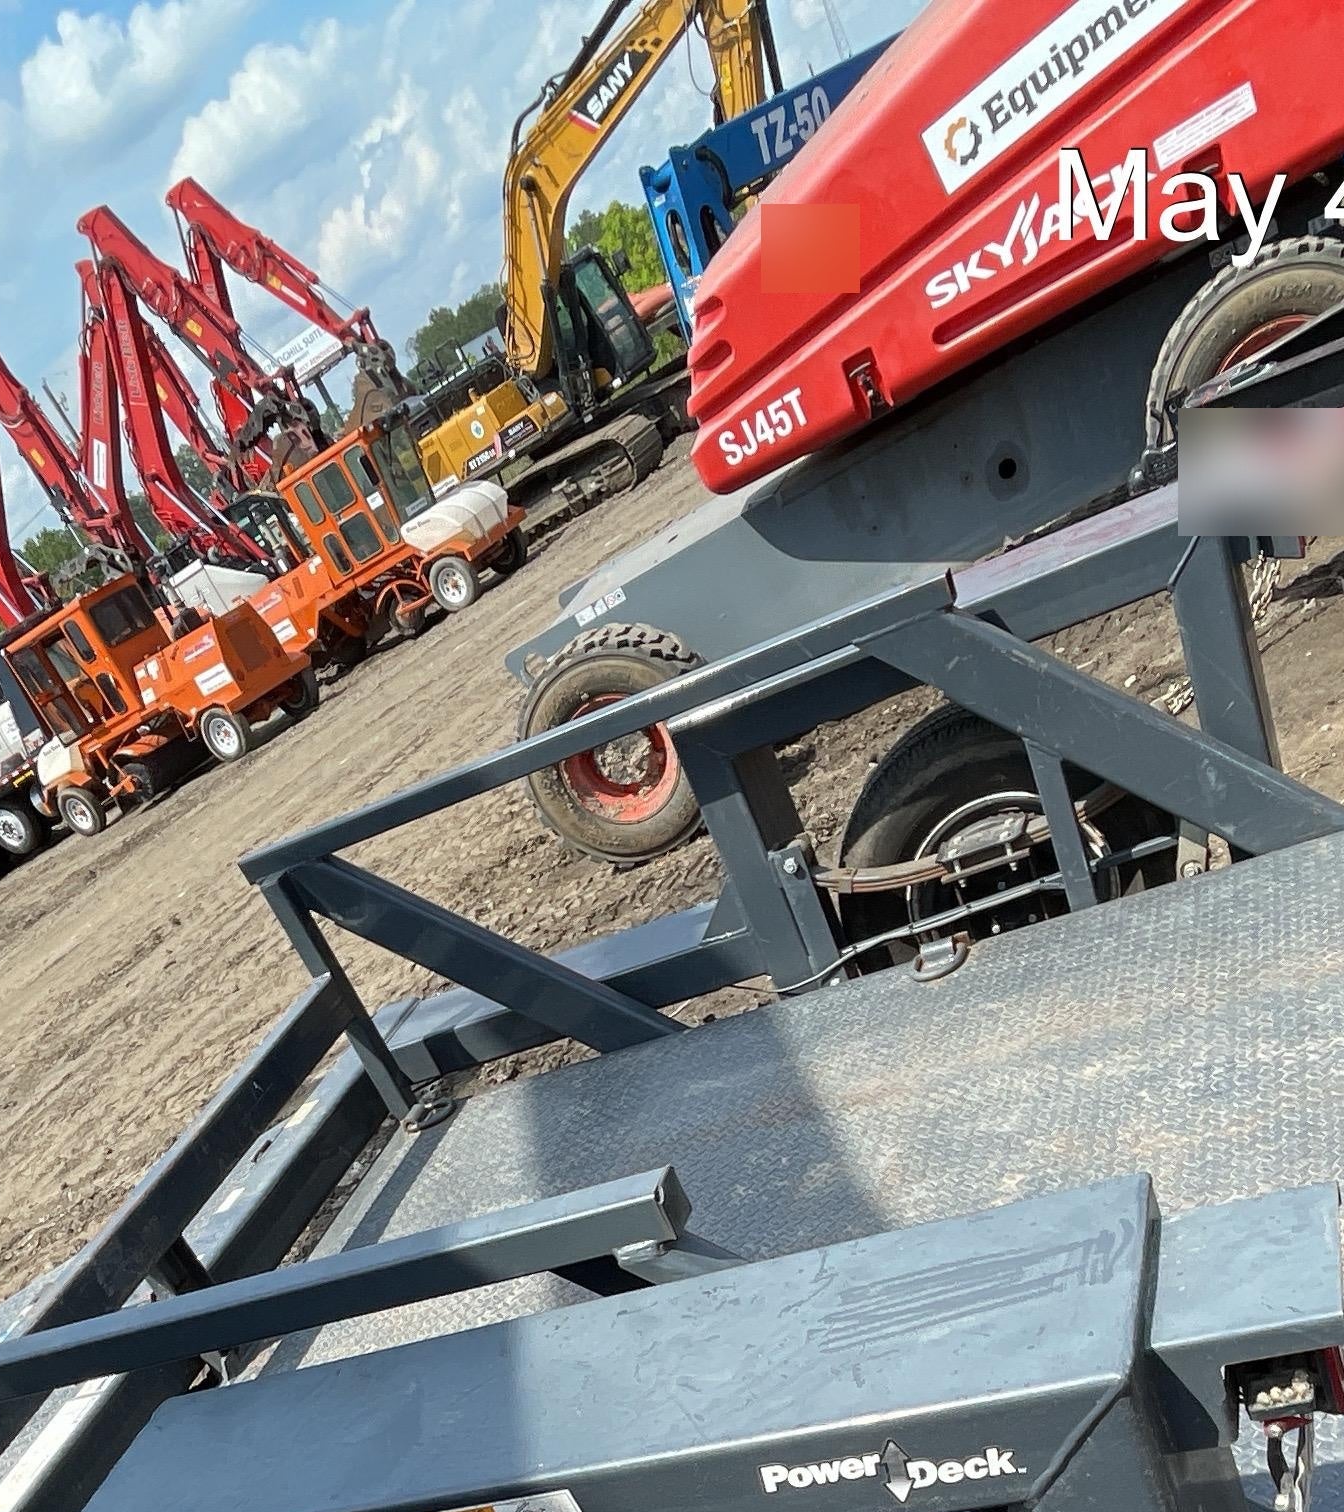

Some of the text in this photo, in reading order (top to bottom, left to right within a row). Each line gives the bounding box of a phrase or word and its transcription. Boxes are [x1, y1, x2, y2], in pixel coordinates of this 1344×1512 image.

[586, 52, 637, 121] SANY
[979, 0, 1159, 135] Equipme
[750, 85, 832, 165] TZ-50
[718, 387, 806, 468] SJ45T
[759, 1446, 1018, 1494] Power Deck
